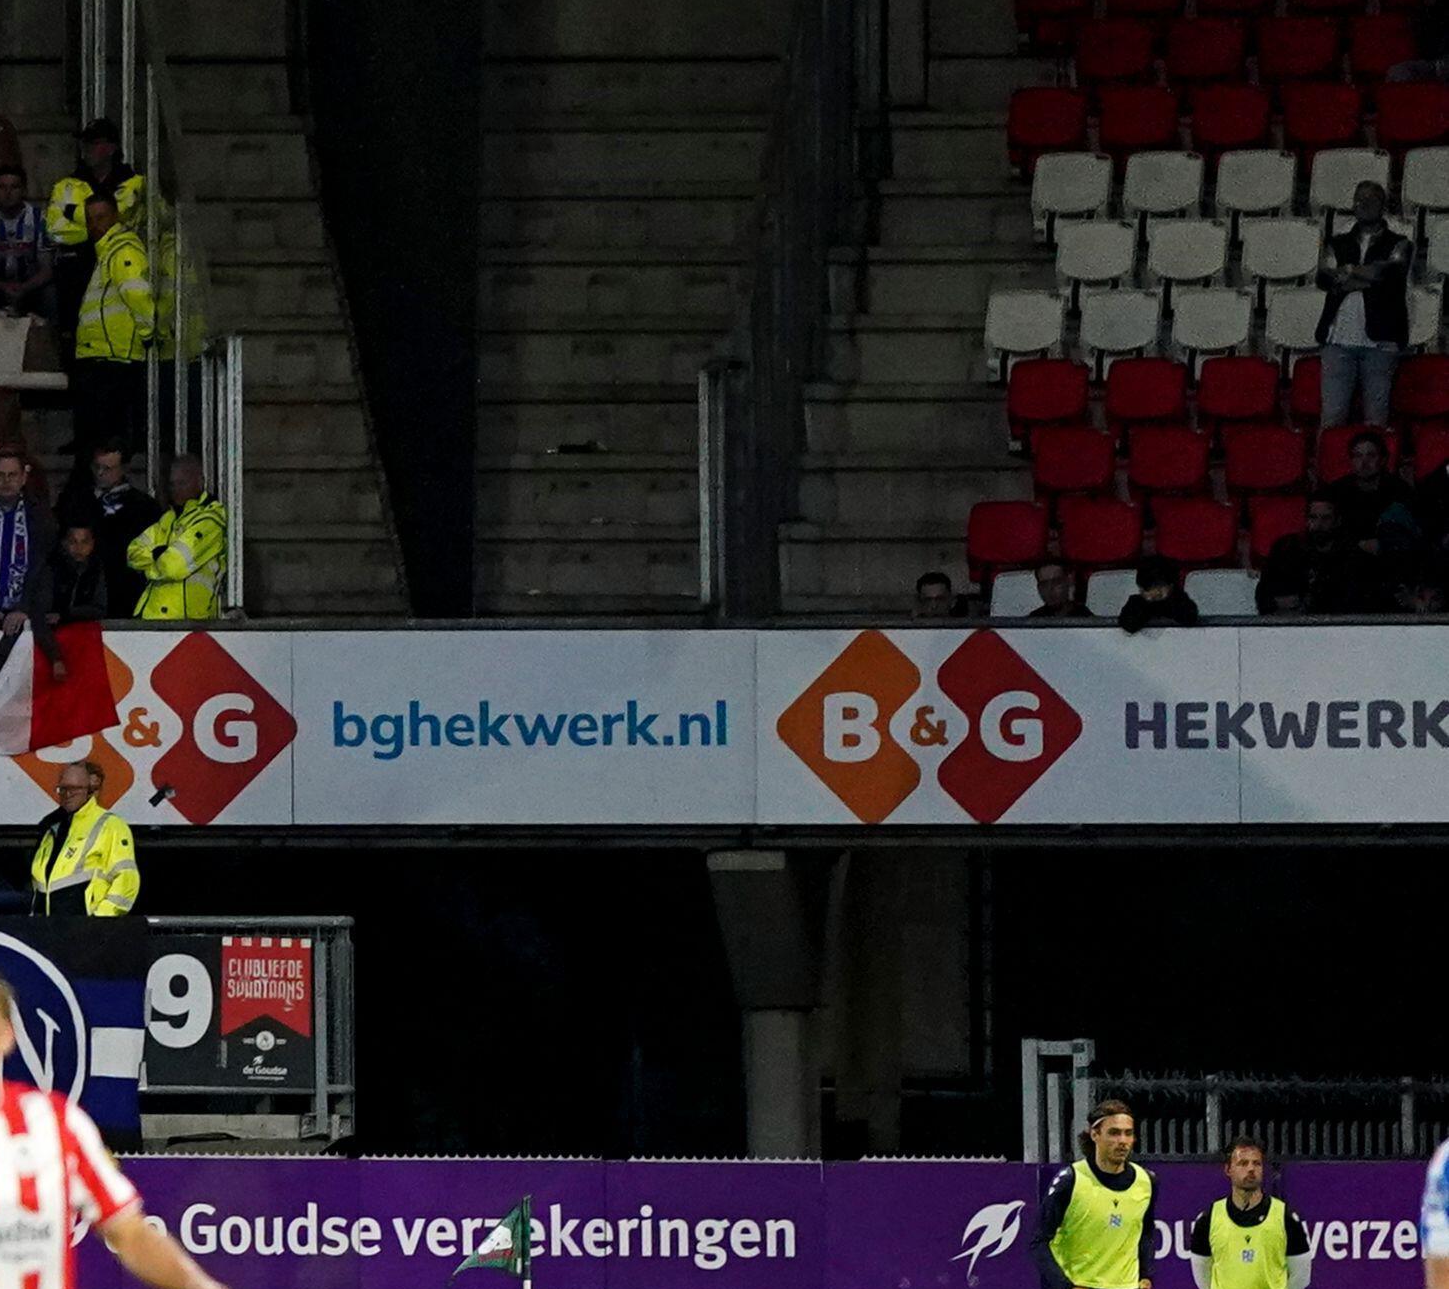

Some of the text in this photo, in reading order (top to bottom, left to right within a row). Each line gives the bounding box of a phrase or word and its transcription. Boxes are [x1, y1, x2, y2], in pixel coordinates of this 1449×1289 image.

[332, 699, 728, 760] bghekwerk.nl
[1124, 699, 1449, 751] HEKWERK
[228, 958, 304, 979] CLUBLIEFDE
[180, 1202, 382, 1256] Goudse
[393, 1204, 797, 1272] verekeringen
[1303, 1219, 1419, 1261] verze
